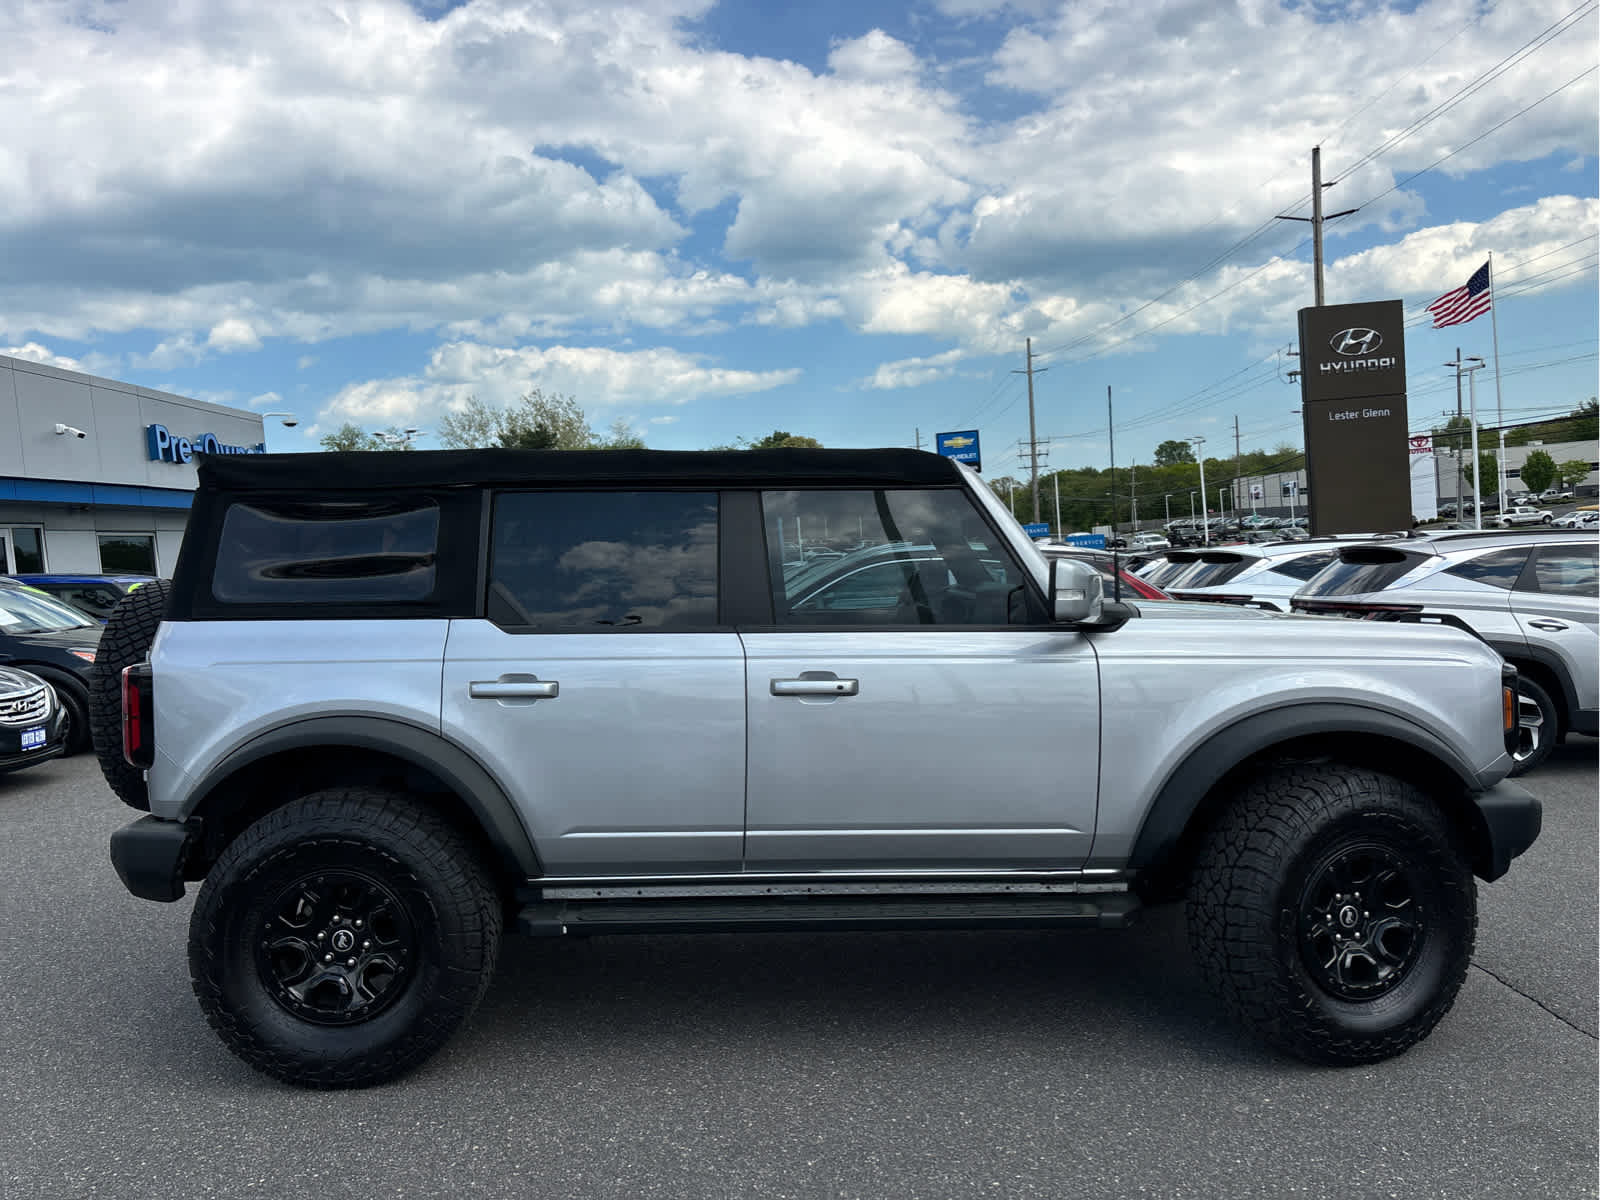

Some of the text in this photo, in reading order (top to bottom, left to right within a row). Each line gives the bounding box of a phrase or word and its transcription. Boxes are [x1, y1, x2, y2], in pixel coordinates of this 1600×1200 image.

[1320, 357, 1396, 372] HYUNDAI
[1329, 408, 1391, 421] Lester Glenn
[147, 424, 266, 464] Pre-O
